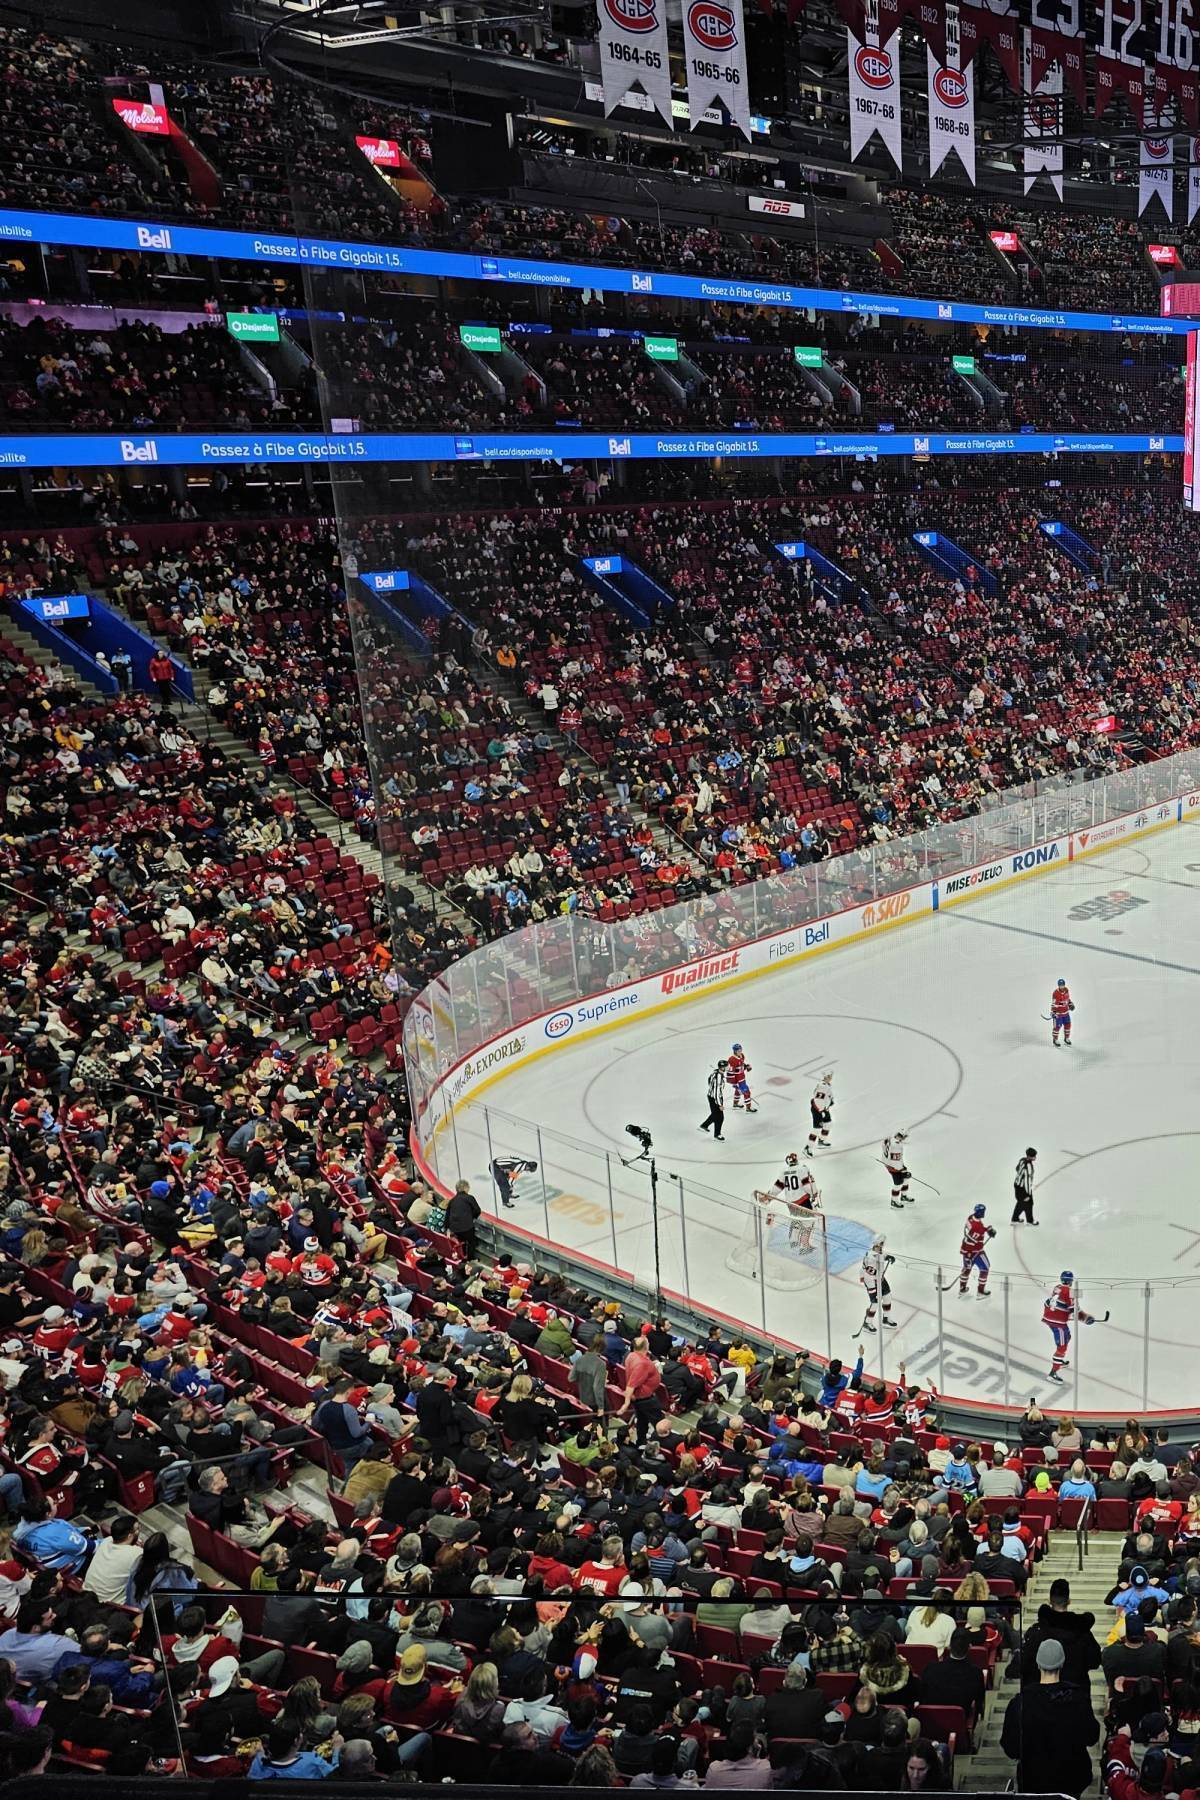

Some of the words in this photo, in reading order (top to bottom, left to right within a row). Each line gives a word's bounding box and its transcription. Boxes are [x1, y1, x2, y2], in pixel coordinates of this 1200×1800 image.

[920, 5, 938, 25] 1982
[961, 20, 977, 40] 1966
[999, 33, 1014, 50] 1981
[607, 41, 662, 69] 1964-65
[1032, 42, 1046, 60] 1970
[691, 58, 740, 85] 1965-66
[1099, 71, 1113, 88] 1963
[855, 98, 895, 119] 1967-68
[121, 109, 163, 128] Molson
[934, 116, 970, 137] 1968-69
[763, 200, 791, 214] RDS
[138, 227, 171, 249] Bell
[254, 240, 297, 257] Passez
[300, 244, 308, 258] à
[311, 246, 336, 260] Fibe
[340, 250, 384, 265] Gigabit
[508, 271, 571, 284] bell.ca/disponibilite
[632, 275, 652, 291] Bell
[702, 284, 727, 296] Passez
[736, 287, 752, 298] Fibe
[754, 289, 780, 303] Gigabit
[938, 305, 952, 318] Bell
[984, 311, 1007, 321] Passez
[242, 322, 275, 334] Desjardins
[471, 334, 499, 344] Desjardins
[121, 441, 157, 461] Bell
[202, 443, 249, 457] Passez
[254, 444, 262, 456] à
[266, 443, 295, 456] Fibe
[299, 443, 347, 460] Gigabit
[349, 443, 367, 456] 1,5.
[484, 447, 553, 457] bell.ca/disponibilite
[609, 438, 631, 455] Bell
[657, 441, 686, 452] Passez
[696, 440, 714, 452] Fibe
[715, 441, 746, 455] Gigabit
[914, 438, 929, 452] Bell
[1149, 438, 1164, 450] Bell
[784, 545, 796, 556] Bell
[594, 560, 610, 572] Bell
[375, 576, 395, 588] Bell
[42, 600, 69, 617] Bell
[1012, 843, 1060, 873] RONA
[877, 892, 911, 925] SKIP
[769, 941, 795, 960] Fibe
[805, 922, 829, 946] Bell
[661, 951, 741, 995] Qualinet
[577, 993, 639, 1024] Suprême
[476, 1043, 515, 1075] EXPORT
[784, 1175, 799, 1190] 40
